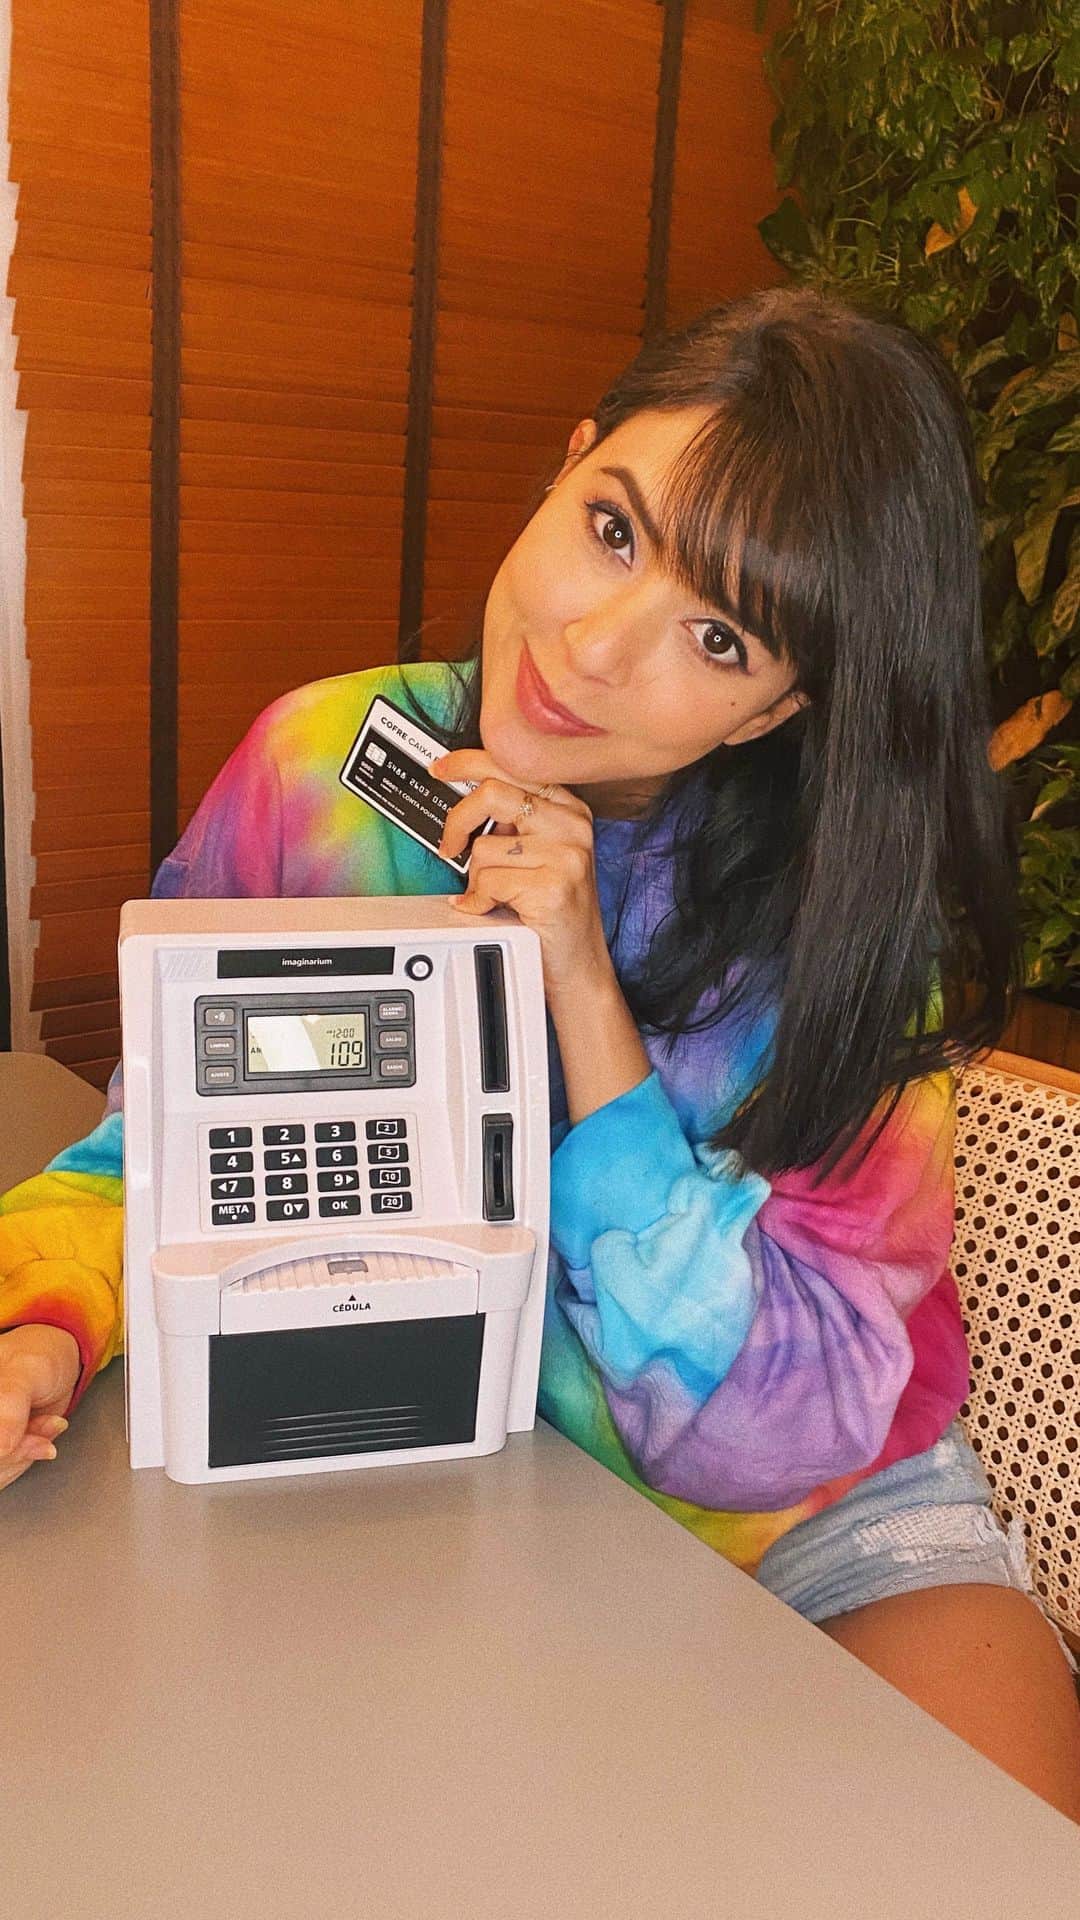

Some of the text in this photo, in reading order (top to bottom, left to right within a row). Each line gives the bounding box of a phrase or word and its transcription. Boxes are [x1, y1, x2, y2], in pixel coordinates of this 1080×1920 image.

[380, 716, 433, 760] COFRE CAIXA
[409, 778, 431, 797] 2603
[402, 792, 420, 809] CONTA
[281, 956, 333, 968] imaginarium
[331, 1040, 363, 1067] 109
[227, 1130, 236, 1143] 1
[280, 1128, 289, 1141] 2
[331, 1125, 340, 1138] 3
[226, 1155, 238, 1168] 4
[281, 1152, 290, 1165] 5
[332, 1149, 342, 1162] 6
[282, 1177, 292, 1189] 8
[334, 1174, 343, 1187] 9
[385, 1173, 396, 1181] 10
[230, 1181, 239, 1193] 7
[332, 1200, 348, 1210] OK
[386, 1198, 398, 1206] 20
[218, 1204, 250, 1215] META
[283, 1203, 293, 1216] 0
[332, 1302, 371, 1313] CÉDULA
